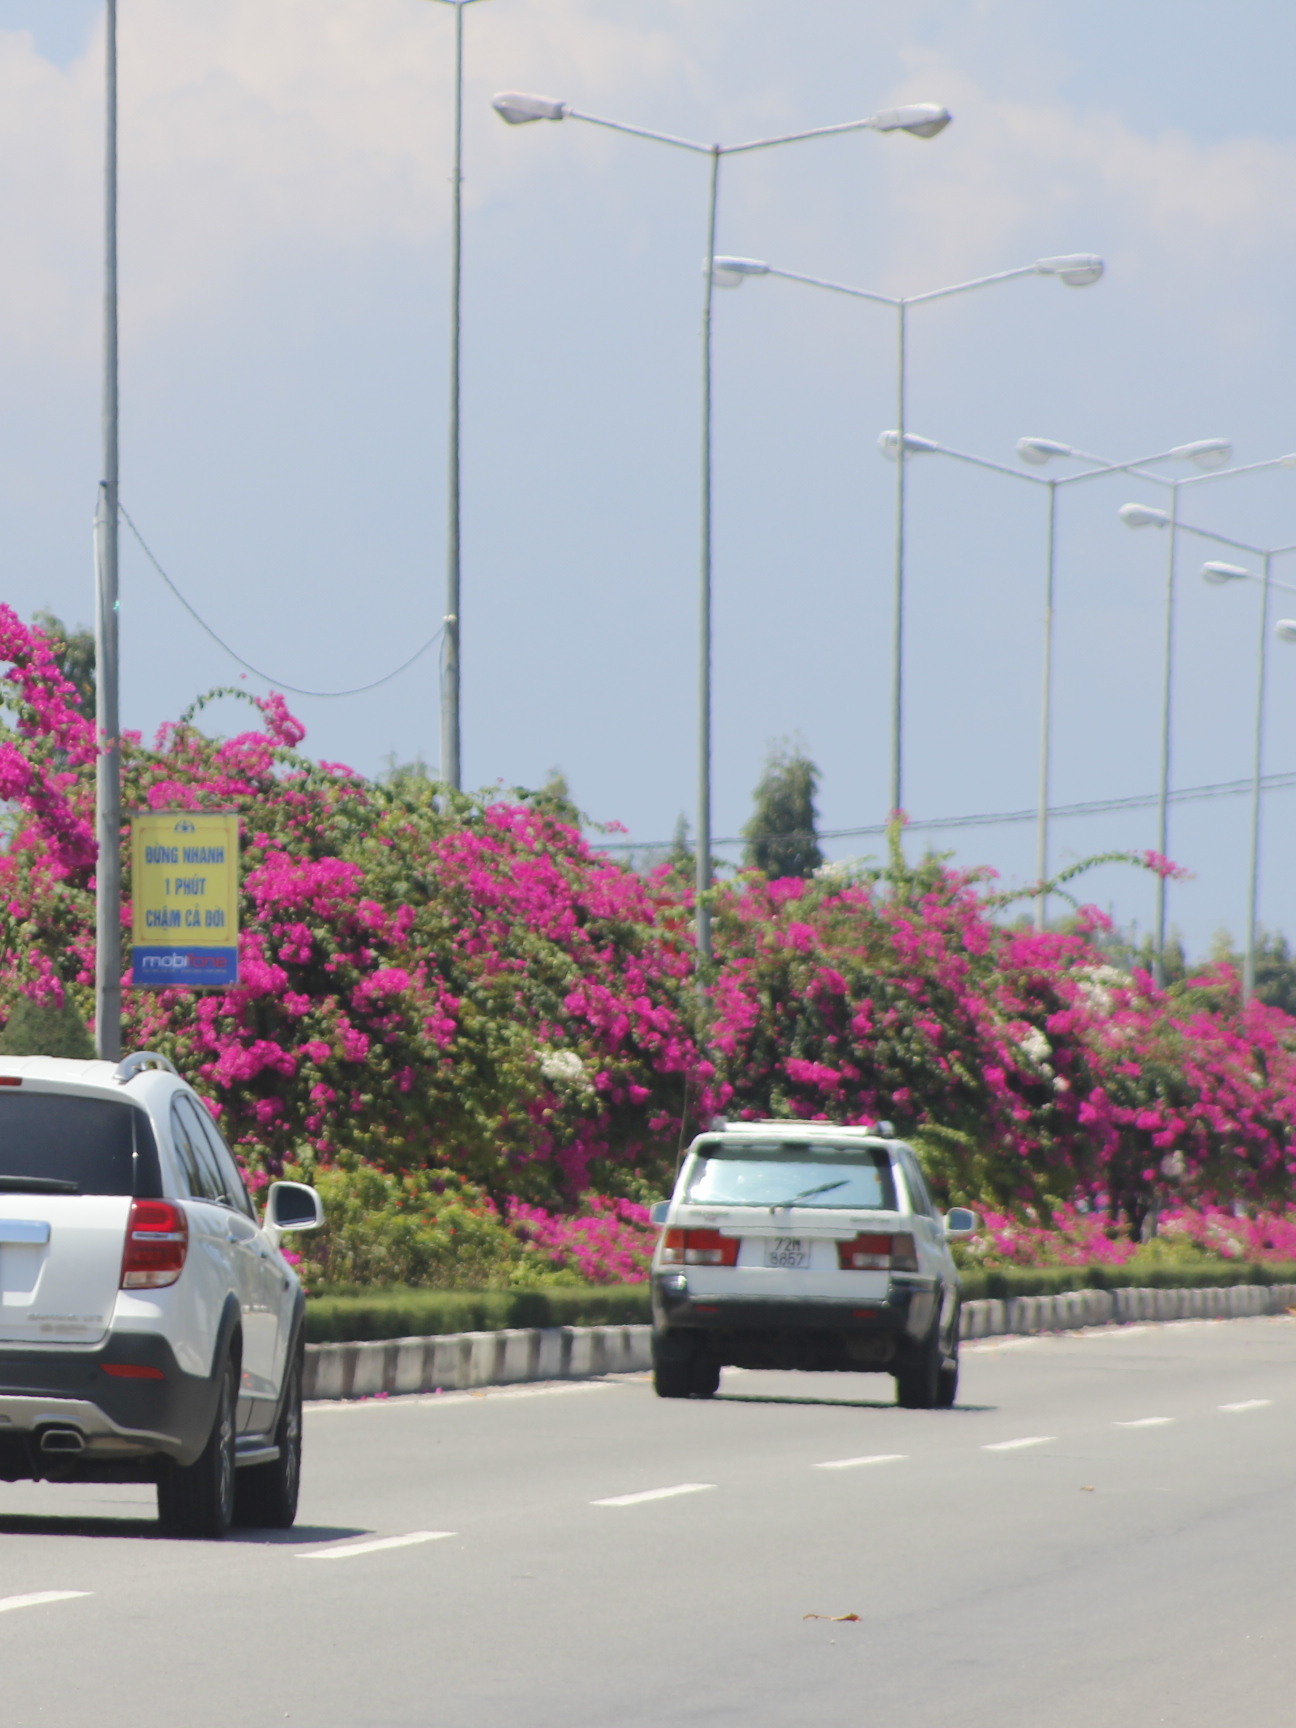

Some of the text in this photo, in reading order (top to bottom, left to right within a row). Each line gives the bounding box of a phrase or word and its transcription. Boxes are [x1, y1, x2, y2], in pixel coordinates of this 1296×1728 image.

[182, 846, 225, 864] NHANH
[164, 874, 206, 895] 1 PHÚT
[185, 904, 201, 927] CẢ
[142, 952, 228, 968] mobifone
